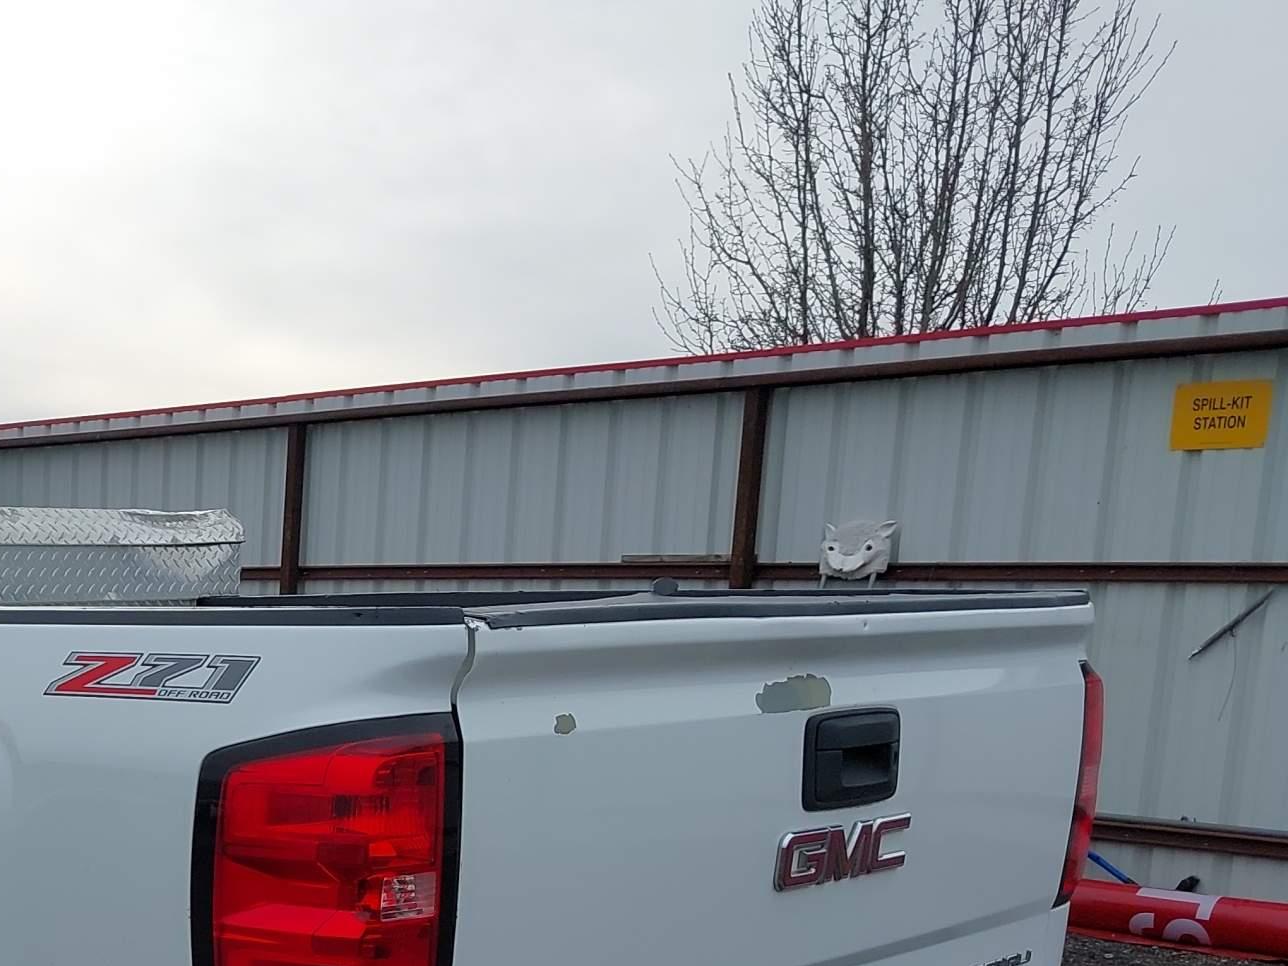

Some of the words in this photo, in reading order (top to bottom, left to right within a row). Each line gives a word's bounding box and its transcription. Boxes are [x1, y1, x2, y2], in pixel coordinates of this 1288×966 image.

[1192, 395, 1253, 412] SPILL-KIT
[1193, 415, 1246, 431] STATION
[43, 651, 261, 704] Z71
[158, 688, 186, 698] OFF
[188, 689, 231, 700] ROAD
[773, 812, 912, 893] GMC
